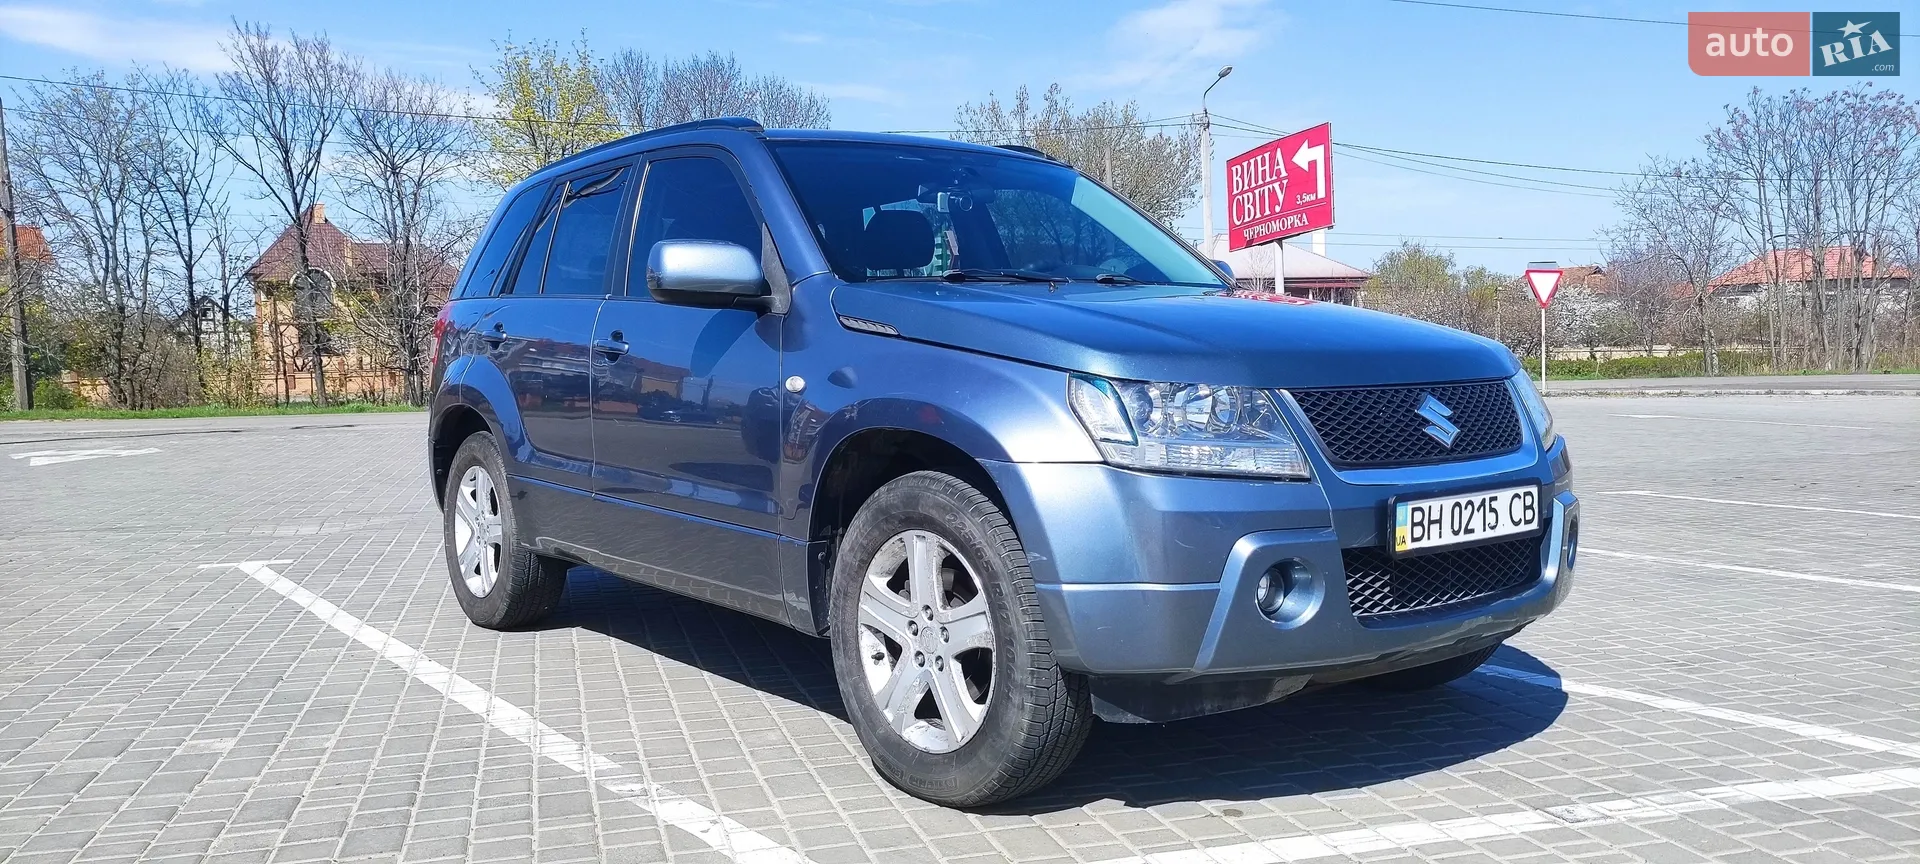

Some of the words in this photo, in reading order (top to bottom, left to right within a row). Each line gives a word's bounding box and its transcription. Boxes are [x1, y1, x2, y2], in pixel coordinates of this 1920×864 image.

[1231, 147, 1289, 195] ВИНА
[1232, 179, 1289, 226] СВІТУ
[1243, 212, 1309, 241] ЧЕРНОМОРКА
[1410, 503, 1444, 543] BH
[1450, 495, 1499, 536] 0215
[1508, 490, 1536, 527] CB
[1396, 535, 1407, 547] UA
[946, 513, 996, 573] 225/65
[990, 581, 1012, 627] R17
